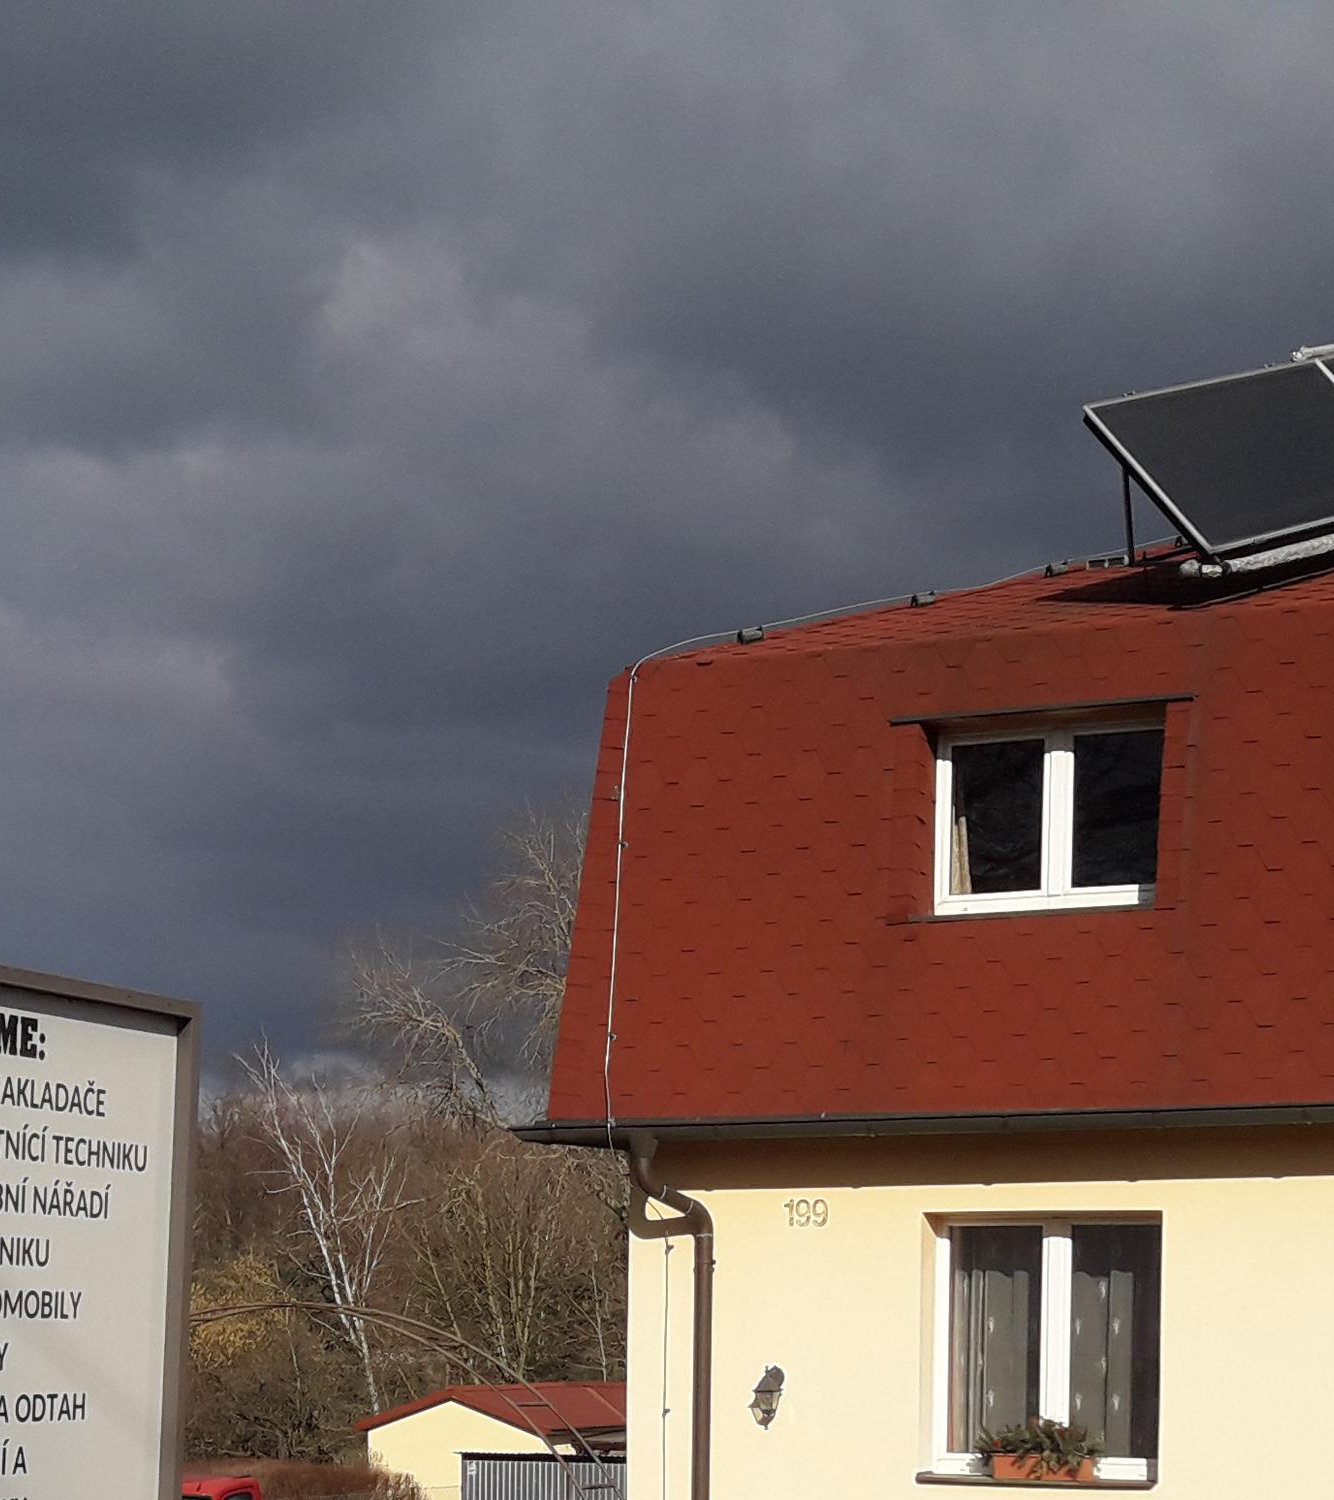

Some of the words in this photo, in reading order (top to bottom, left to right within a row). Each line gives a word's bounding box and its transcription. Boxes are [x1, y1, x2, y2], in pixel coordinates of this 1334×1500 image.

[52, 1135, 148, 1173] TECHNIKU
[32, 1178, 112, 1220] NÁŘADÍ
[783, 1198, 829, 1227] 199
[15, 1393, 87, 1423] ODTAH
[12, 1446, 28, 1475] A
